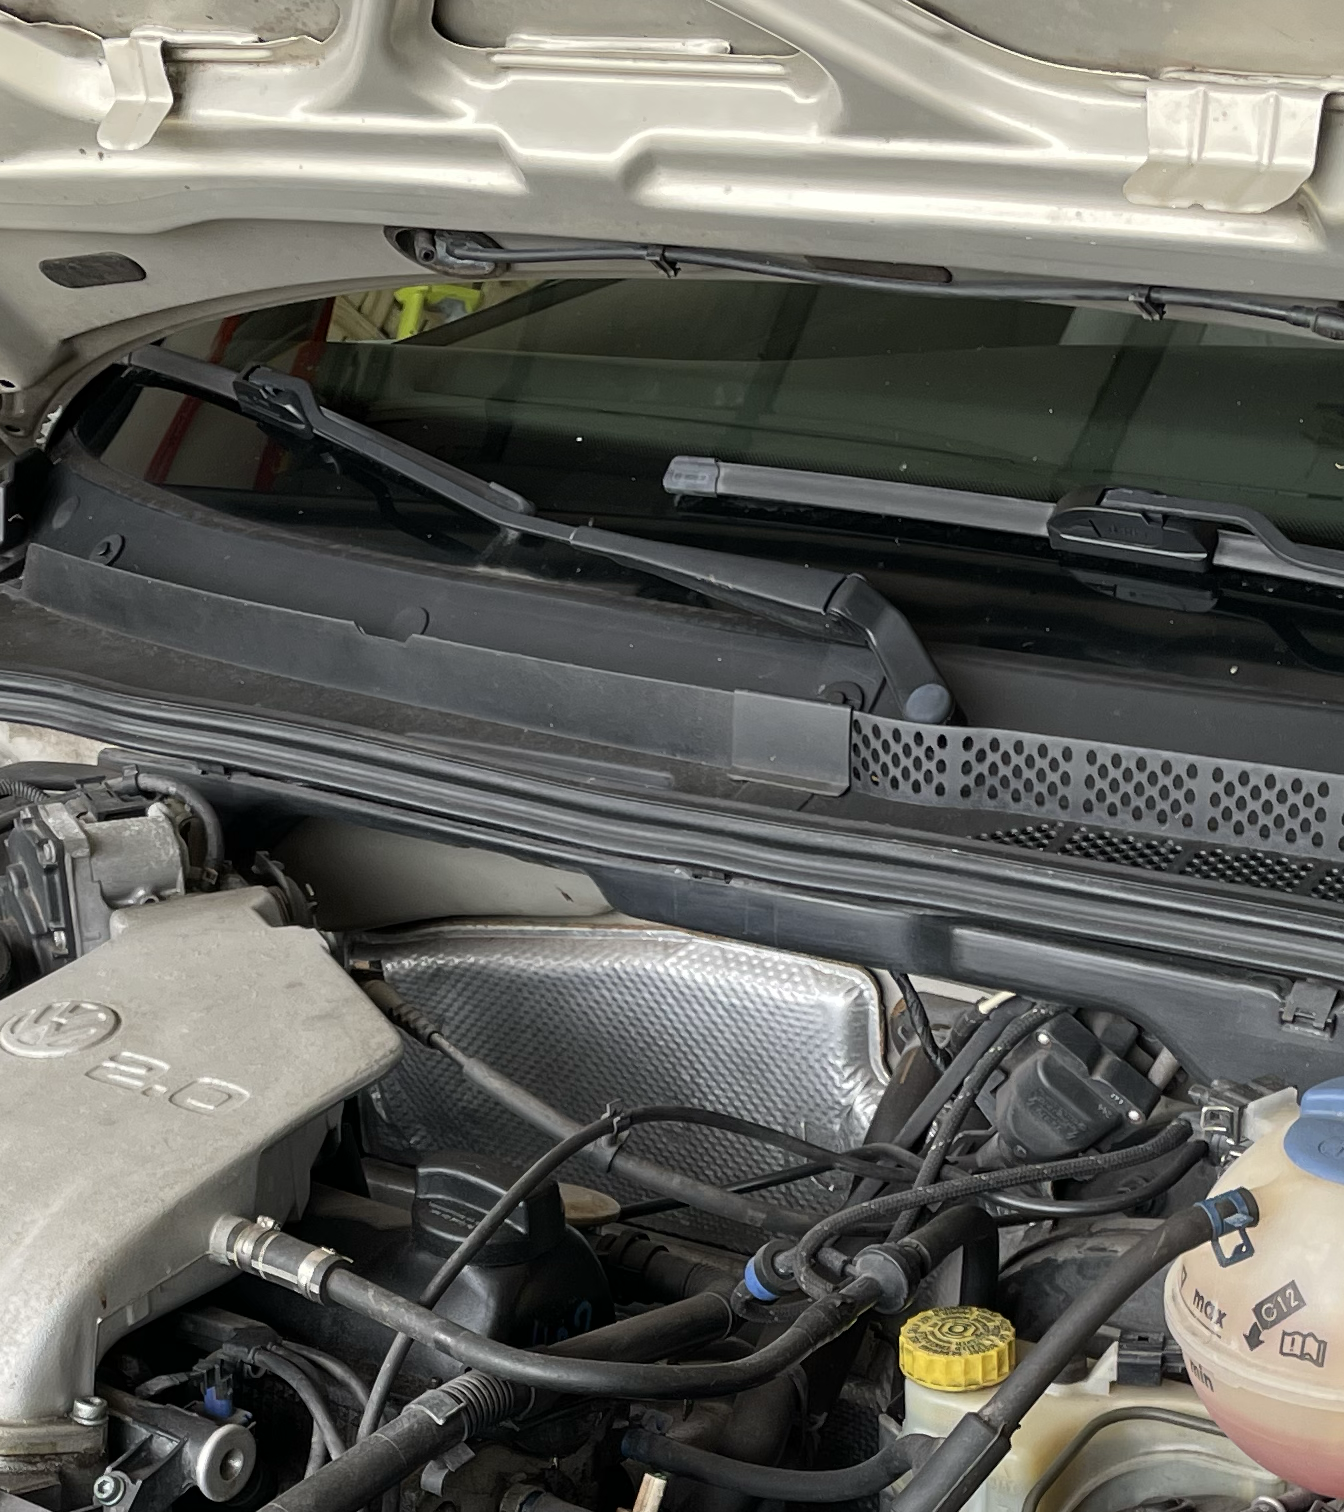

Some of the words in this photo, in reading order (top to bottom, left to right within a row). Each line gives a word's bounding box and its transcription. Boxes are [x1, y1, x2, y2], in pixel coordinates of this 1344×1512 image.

[86, 1050, 250, 1114] 2.0
[1193, 1288, 1227, 1329] max
[1190, 1360, 1215, 1393] min
